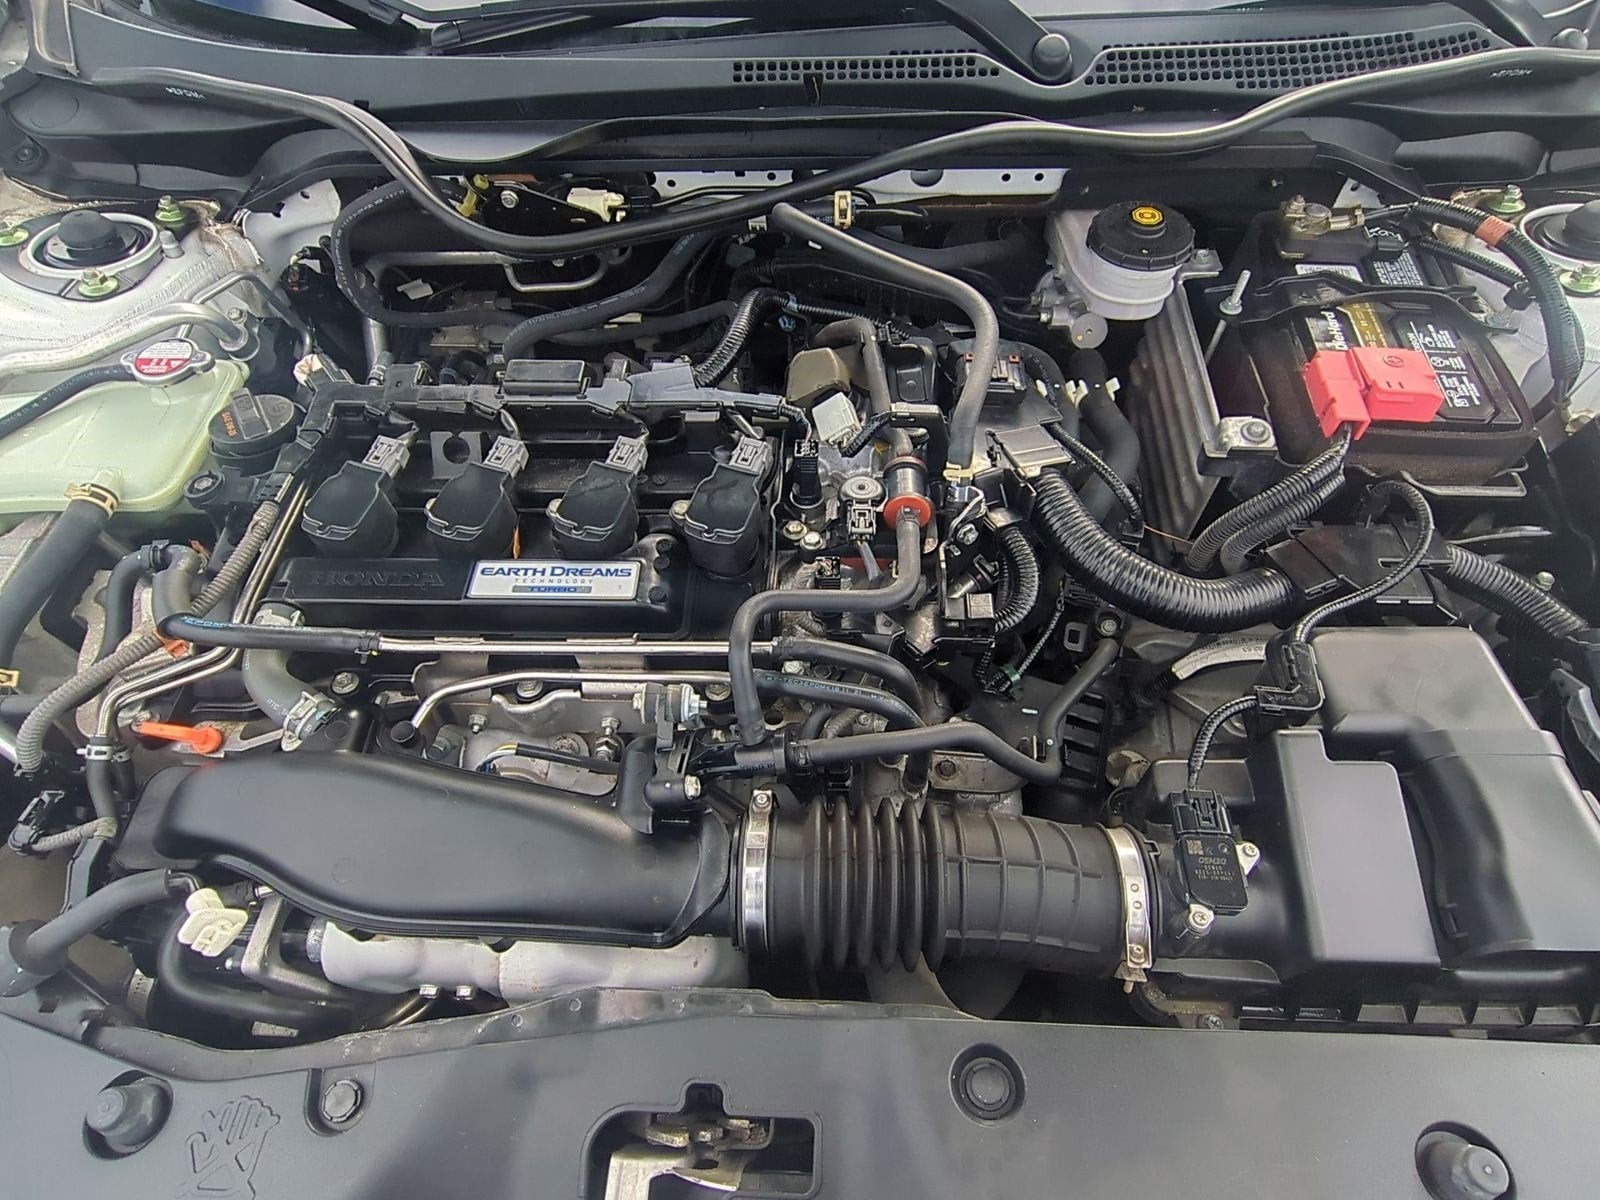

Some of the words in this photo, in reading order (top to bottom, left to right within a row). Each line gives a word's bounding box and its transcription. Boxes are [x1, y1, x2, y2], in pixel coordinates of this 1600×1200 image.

[1321, 310, 1348, 350] DieHard
[480, 566, 546, 577] EARTH
[311, 570, 446, 588] HONDA
[1198, 856, 1227, 865] DENSO
